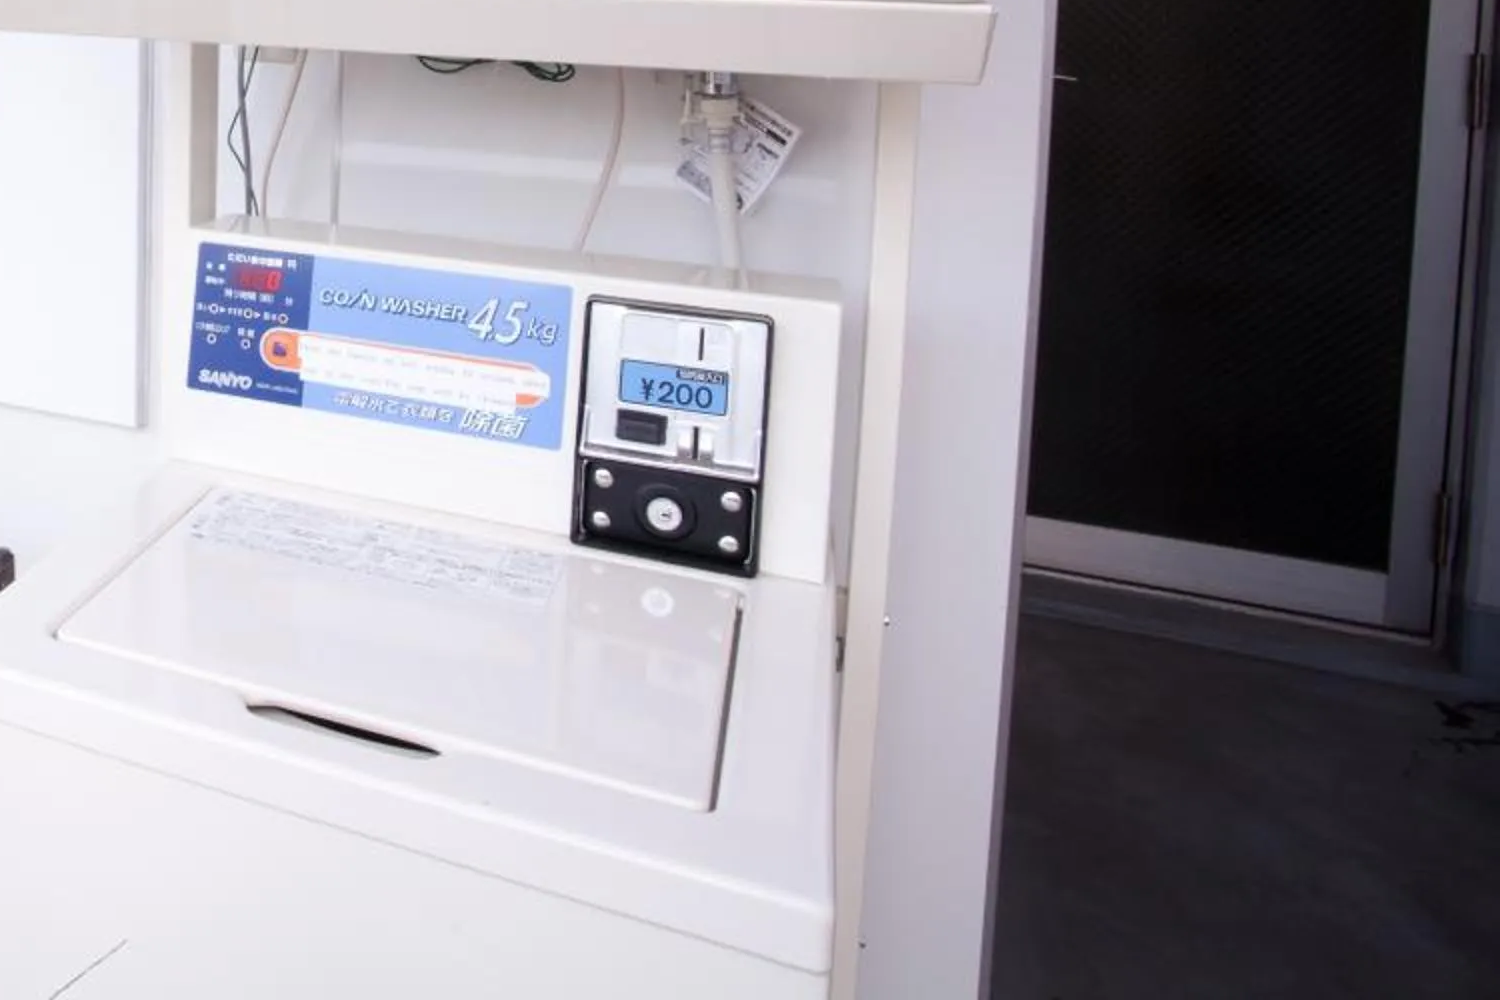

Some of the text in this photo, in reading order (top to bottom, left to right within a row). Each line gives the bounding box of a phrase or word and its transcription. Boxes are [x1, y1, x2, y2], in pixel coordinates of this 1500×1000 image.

[380, 296, 468, 324] WASHER
[198, 369, 253, 390] SANYO
[639, 377, 713, 409] ¥200
